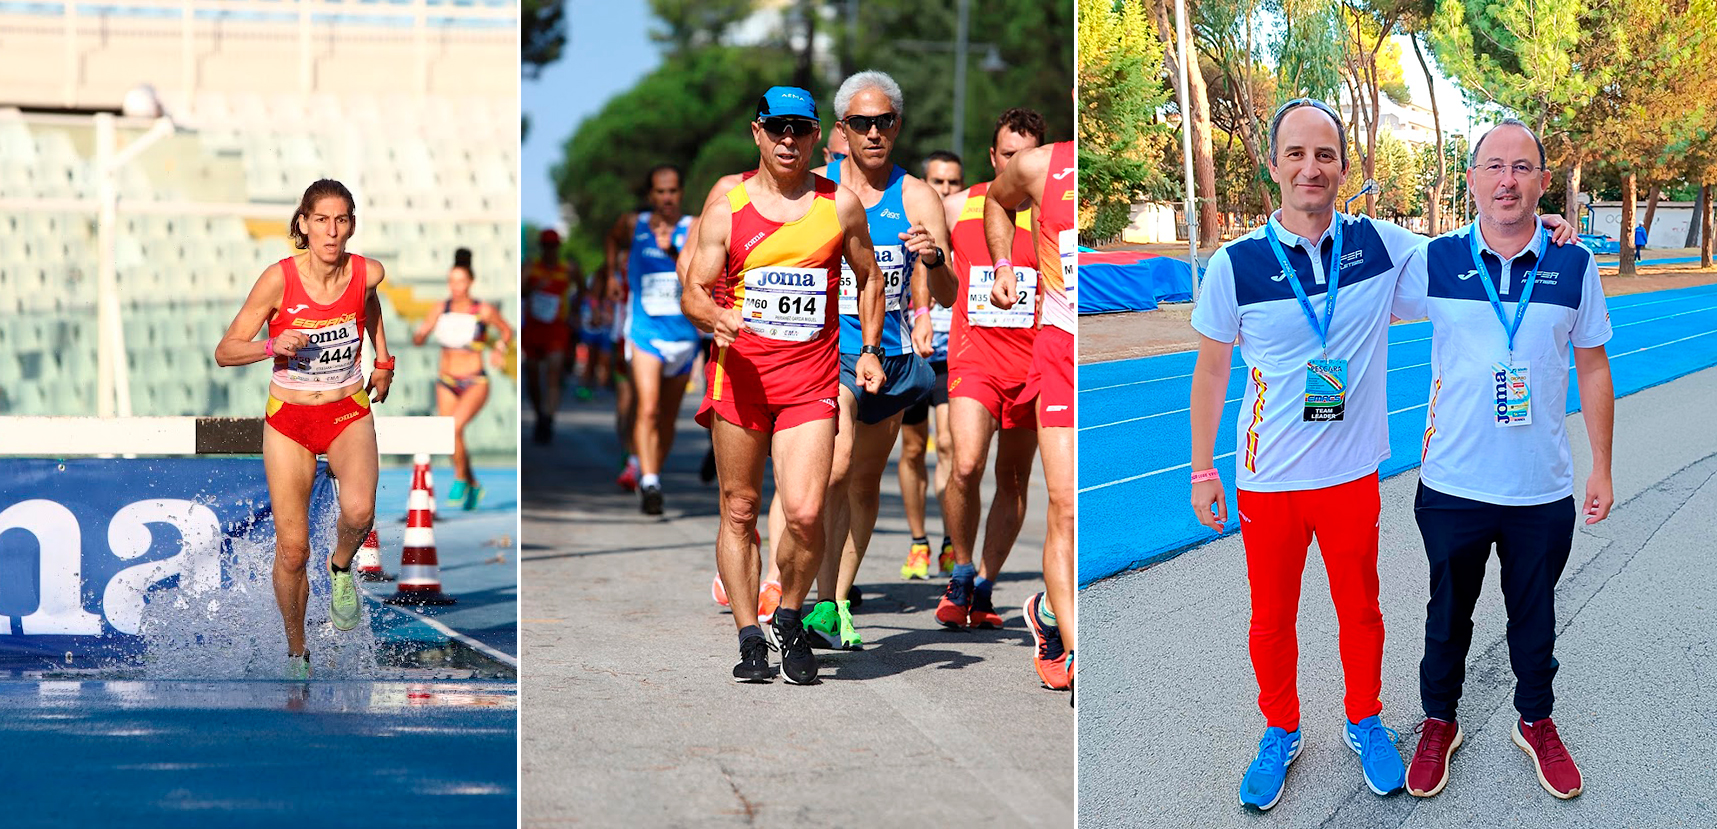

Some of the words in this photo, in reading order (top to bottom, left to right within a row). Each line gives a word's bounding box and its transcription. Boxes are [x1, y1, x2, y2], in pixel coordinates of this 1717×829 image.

[757, 271, 815, 287] Joma
[746, 298, 768, 309] M60
[778, 296, 816, 315] 614
[969, 294, 988, 302] M35
[292, 312, 356, 329] ESPAÑA
[308, 327, 349, 344] oma
[320, 346, 352, 365] 444
[1495, 369, 1510, 424] Joma
